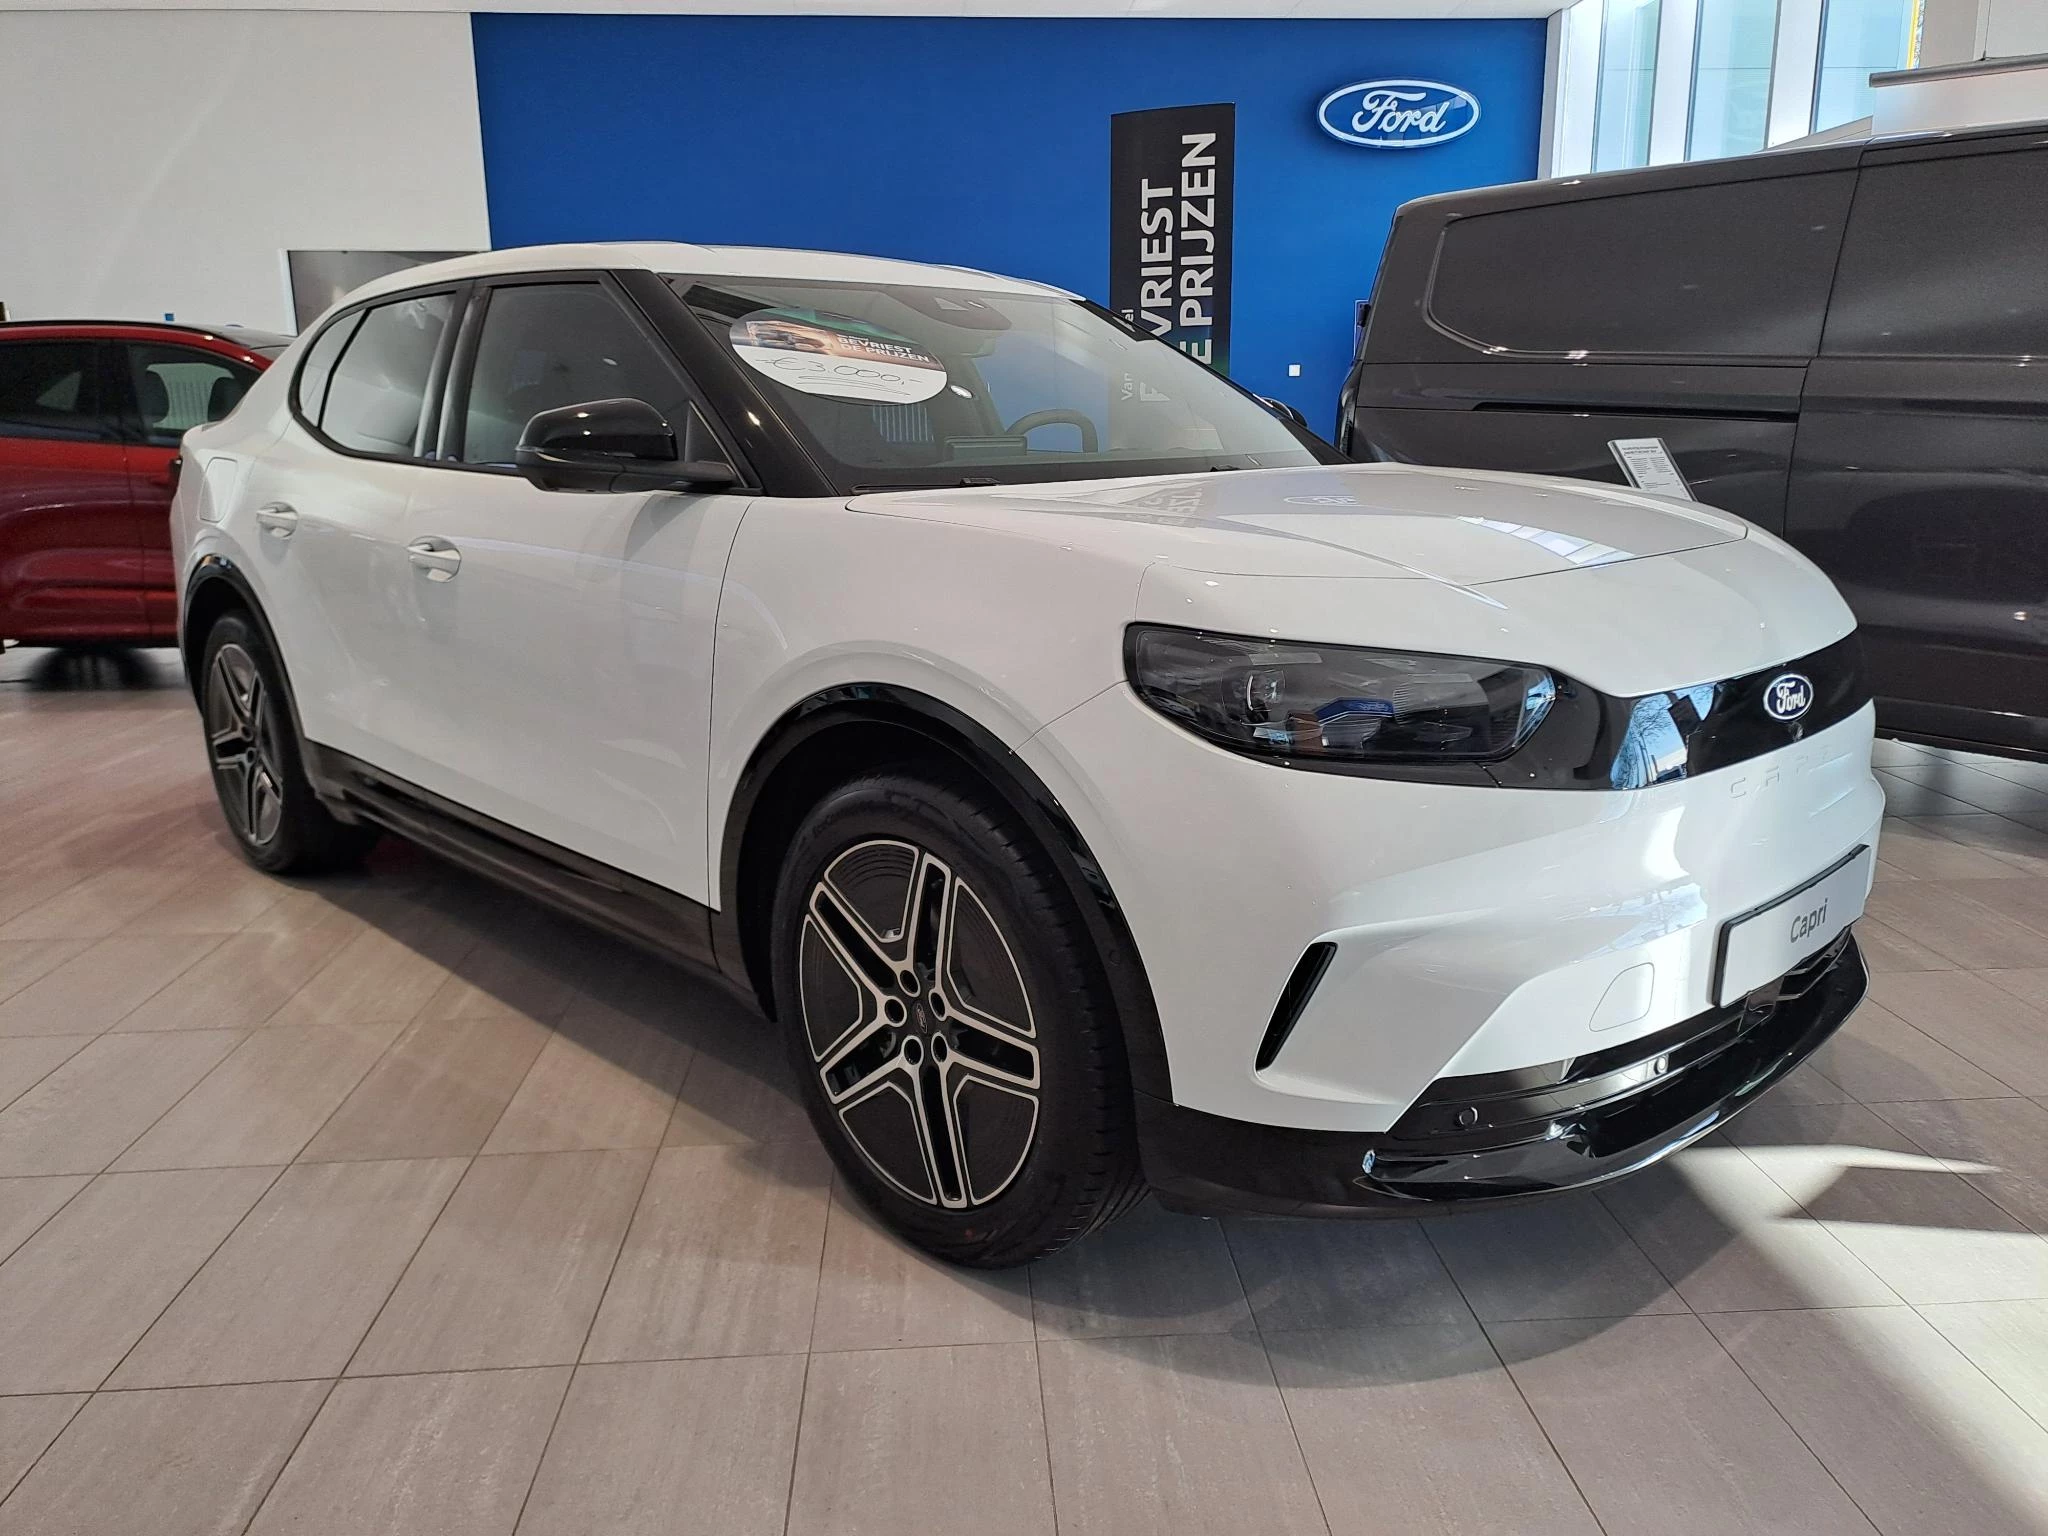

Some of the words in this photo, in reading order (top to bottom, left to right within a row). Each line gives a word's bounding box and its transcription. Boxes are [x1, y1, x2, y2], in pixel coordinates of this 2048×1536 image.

[1352, 90, 1450, 133] Ford
[1179, 132, 1217, 327] PRIJZEN
[1140, 178, 1173, 337] VRIEST
[838, 336, 912, 354] BEVRIEST
[840, 343, 862, 352] DE
[865, 346, 930, 362] PRIJZEN
[1179, 339, 1212, 365] E
[1776, 681, 1806, 714] Ford
[1790, 897, 1828, 943] Capri
